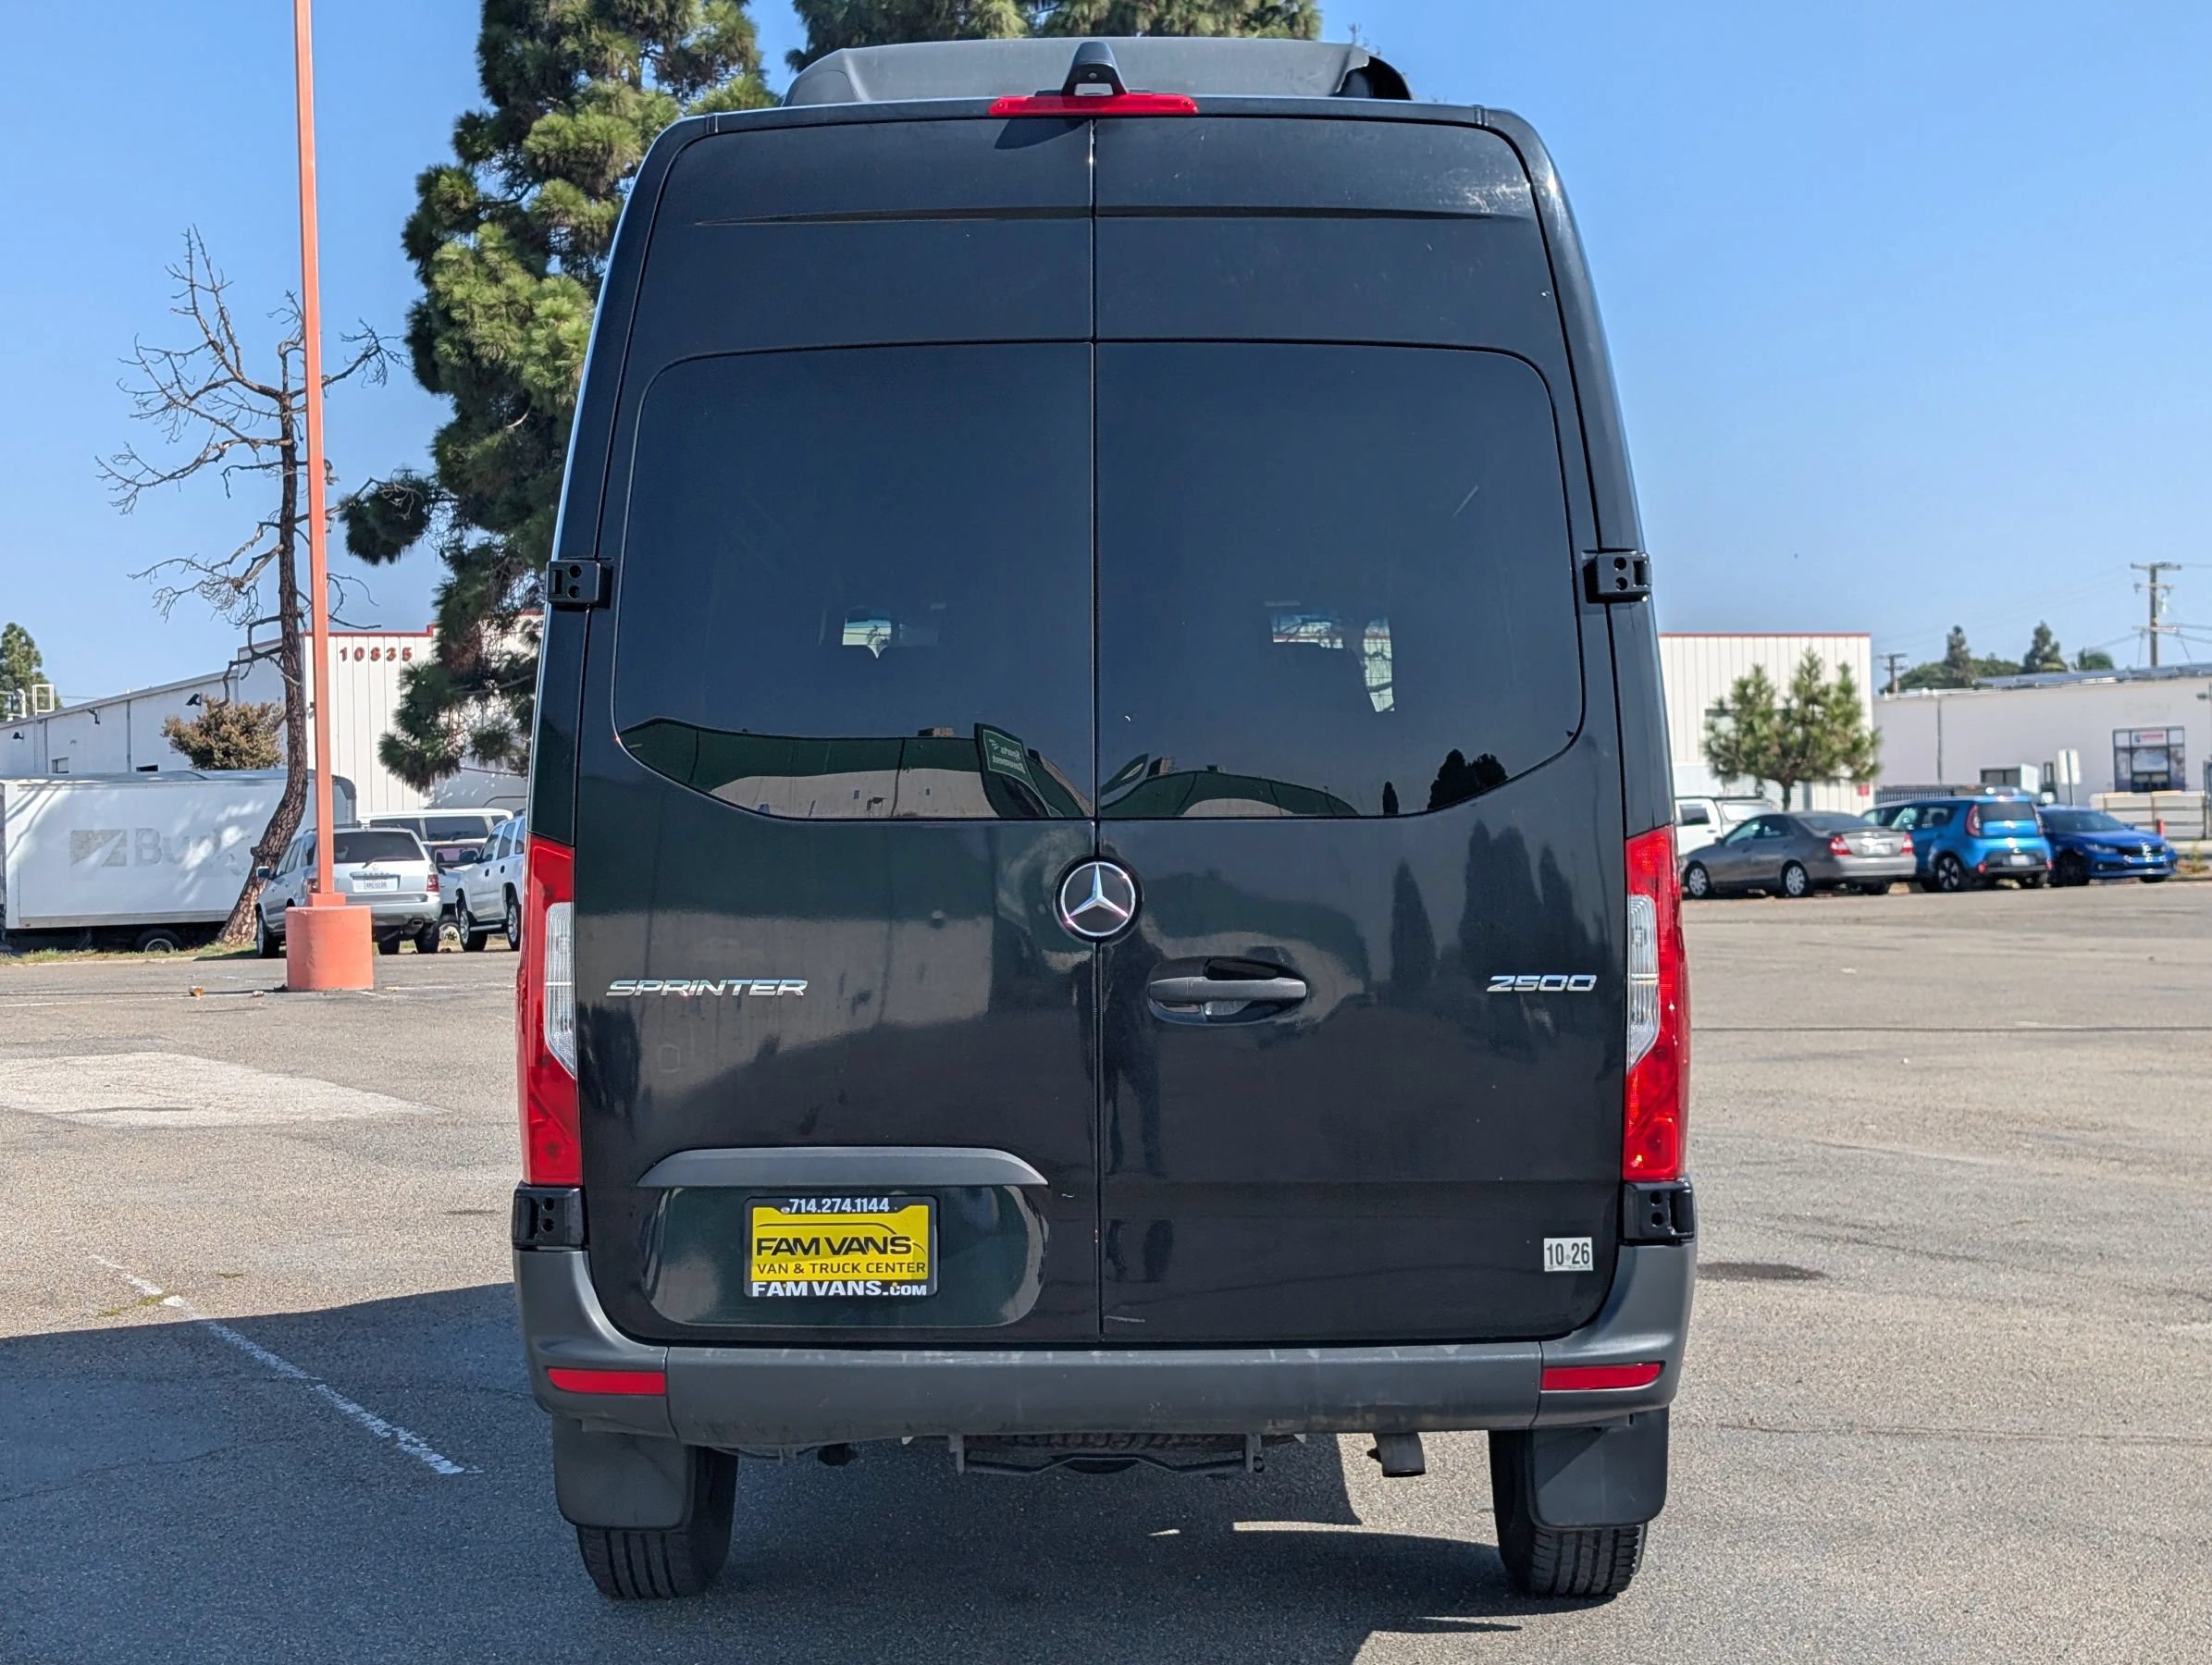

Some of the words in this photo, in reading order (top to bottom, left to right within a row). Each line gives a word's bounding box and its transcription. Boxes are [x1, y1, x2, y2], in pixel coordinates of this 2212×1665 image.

[605, 979, 809, 997] SPRINTER
[1486, 974, 1598, 992] 2500
[789, 1197, 890, 1214] 714.274.1144
[756, 1237, 821, 1256] FAM
[823, 1235, 912, 1256] VANS
[757, 1263, 788, 1275] VAN
[793, 1263, 805, 1274] &
[809, 1263, 861, 1274] TRUCK
[866, 1262, 926, 1274] CENTER
